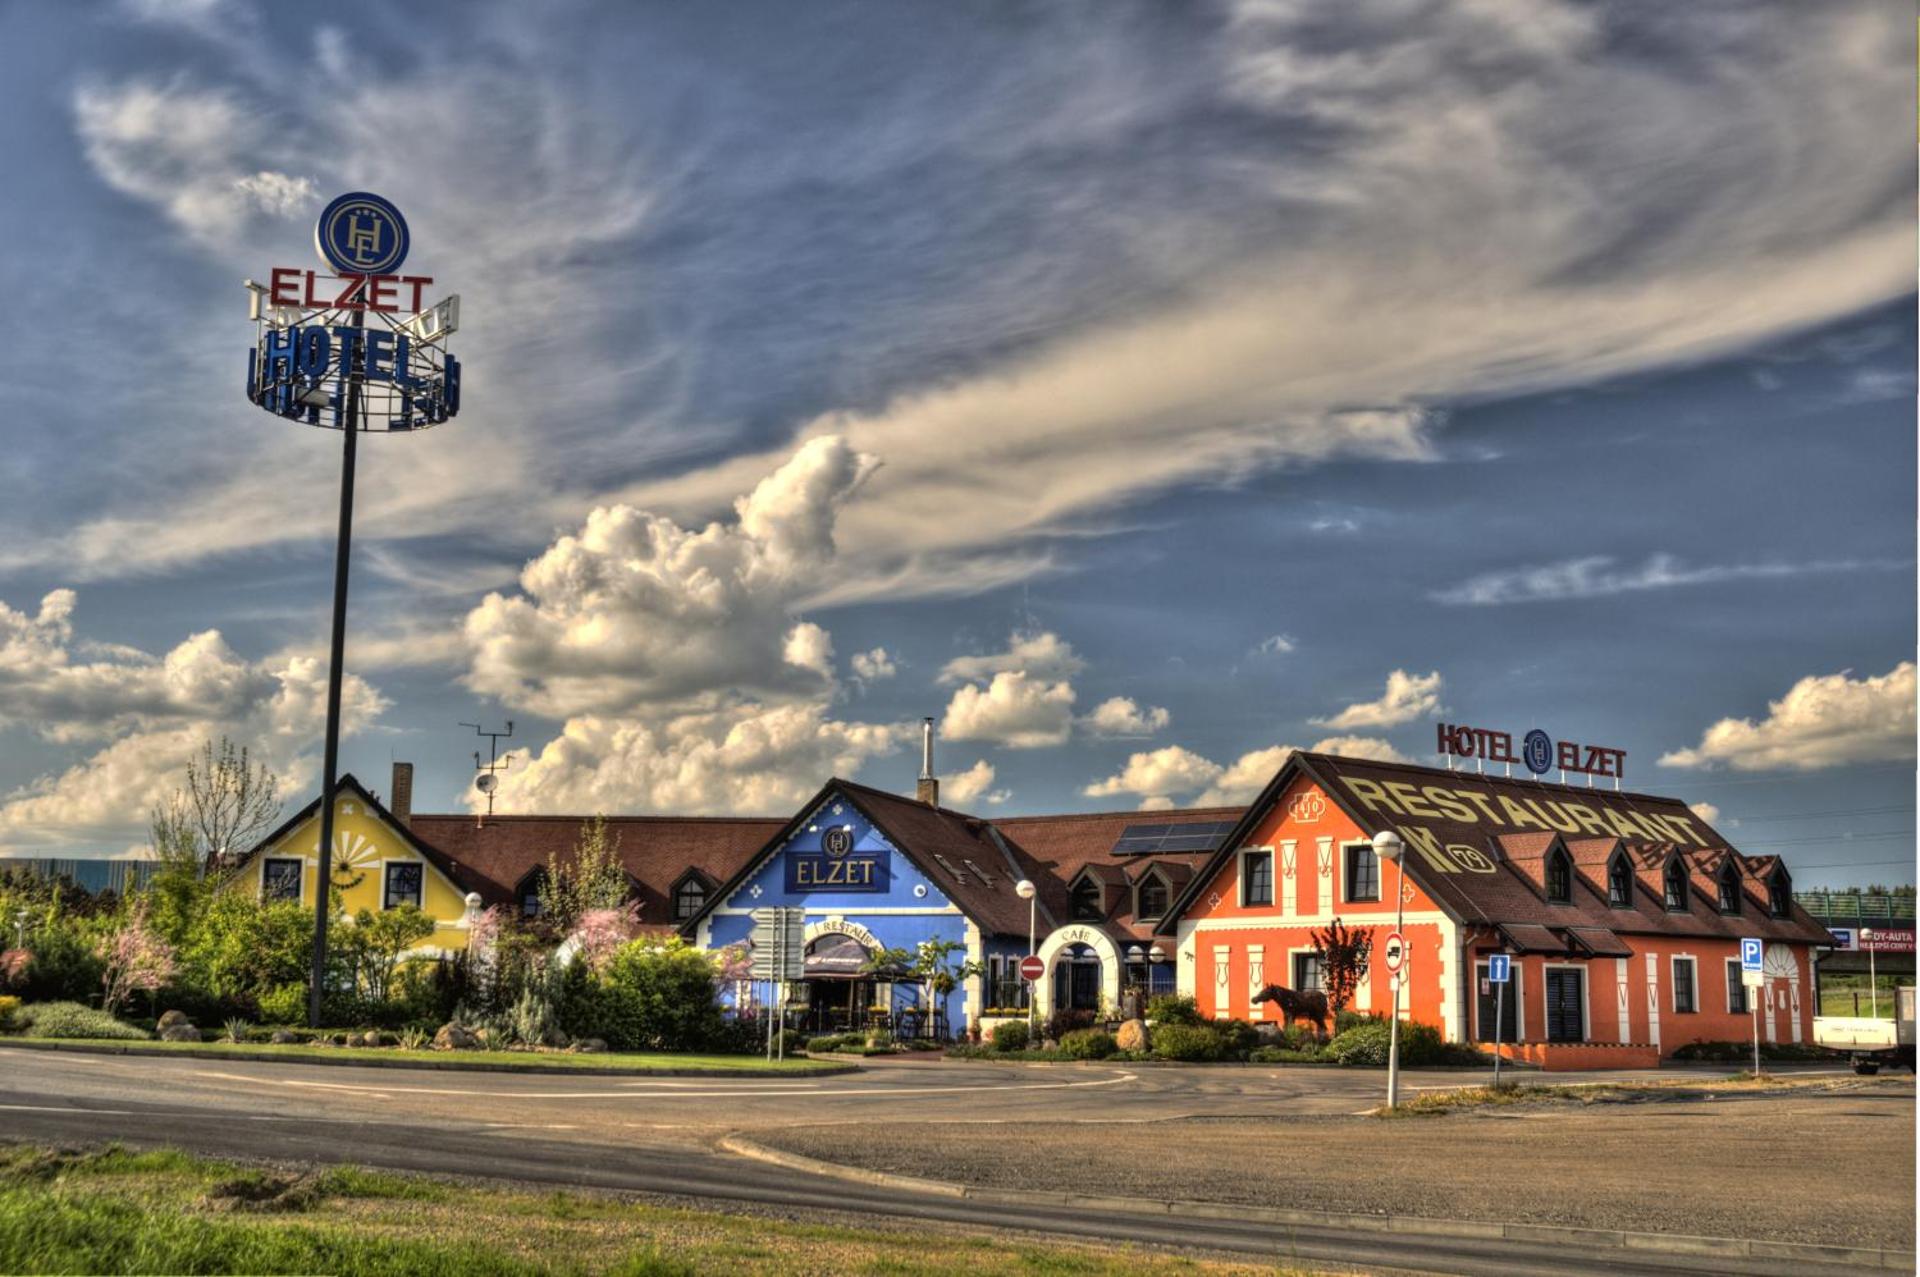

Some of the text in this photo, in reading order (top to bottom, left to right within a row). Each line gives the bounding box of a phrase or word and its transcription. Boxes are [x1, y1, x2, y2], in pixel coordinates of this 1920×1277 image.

[270, 267, 433, 314] ELZET
[265, 325, 424, 388] HOTEL
[1437, 723, 1521, 764] HOTEL
[1557, 741, 1627, 778] ELZET
[1338, 776, 1709, 847] RESTAURANT
[797, 860, 875, 884] ELZET
[1452, 850, 1486, 868] 79
[1745, 942, 1758, 961] P
